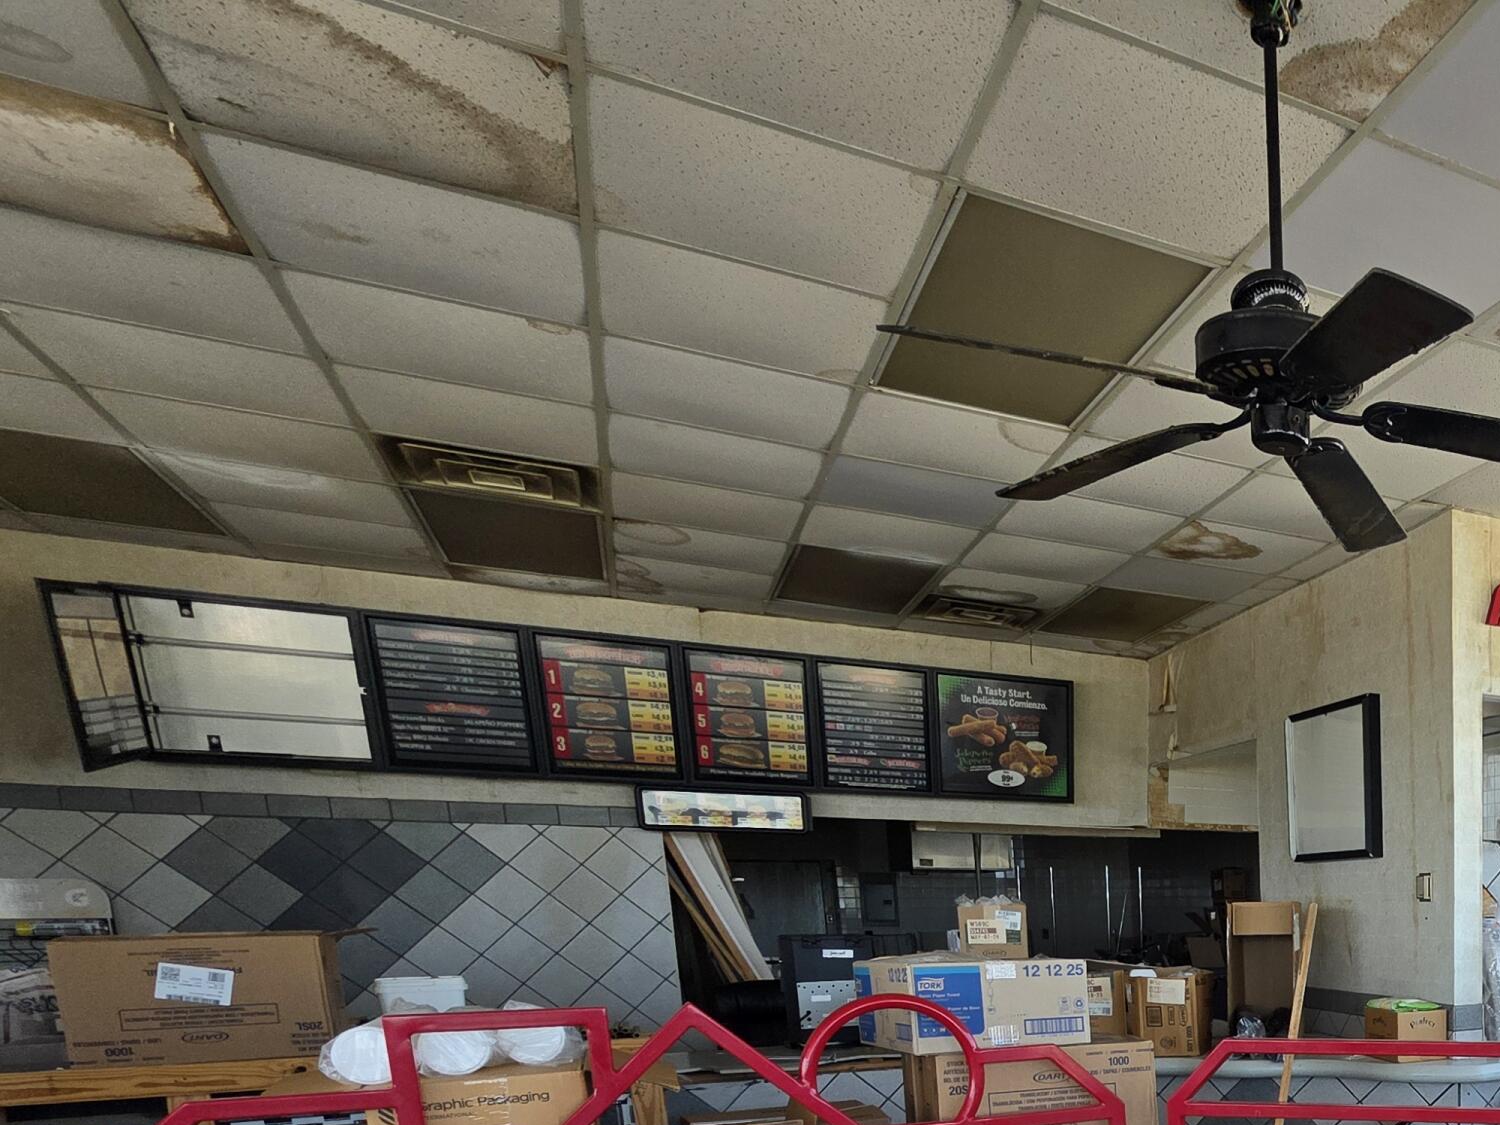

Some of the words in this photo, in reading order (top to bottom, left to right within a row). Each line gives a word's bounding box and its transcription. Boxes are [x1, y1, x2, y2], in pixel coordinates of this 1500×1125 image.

[548, 670, 555, 685] 1
[695, 682, 704, 697] 4
[977, 686, 982, 694] A
[985, 686, 1006, 698] Tasty
[1008, 689, 1032, 698] Start.
[960, 694, 972, 703] Un
[972, 695, 1008, 707] Delicioso
[1009, 699, 1048, 710] Comienzo.
[552, 704, 562, 719] 2
[697, 714, 706, 728] 5
[556, 737, 566, 752] 3
[701, 745, 708, 759] 6
[1023, 965, 1040, 977] 12
[1045, 964, 1062, 977] 12
[1067, 964, 1084, 976] 25
[919, 981, 942, 990] TORK
[1108, 1056, 1130, 1066] 1000
[949, 1086, 969, 1096] 20S
[477, 1091, 550, 1108] Packaging
